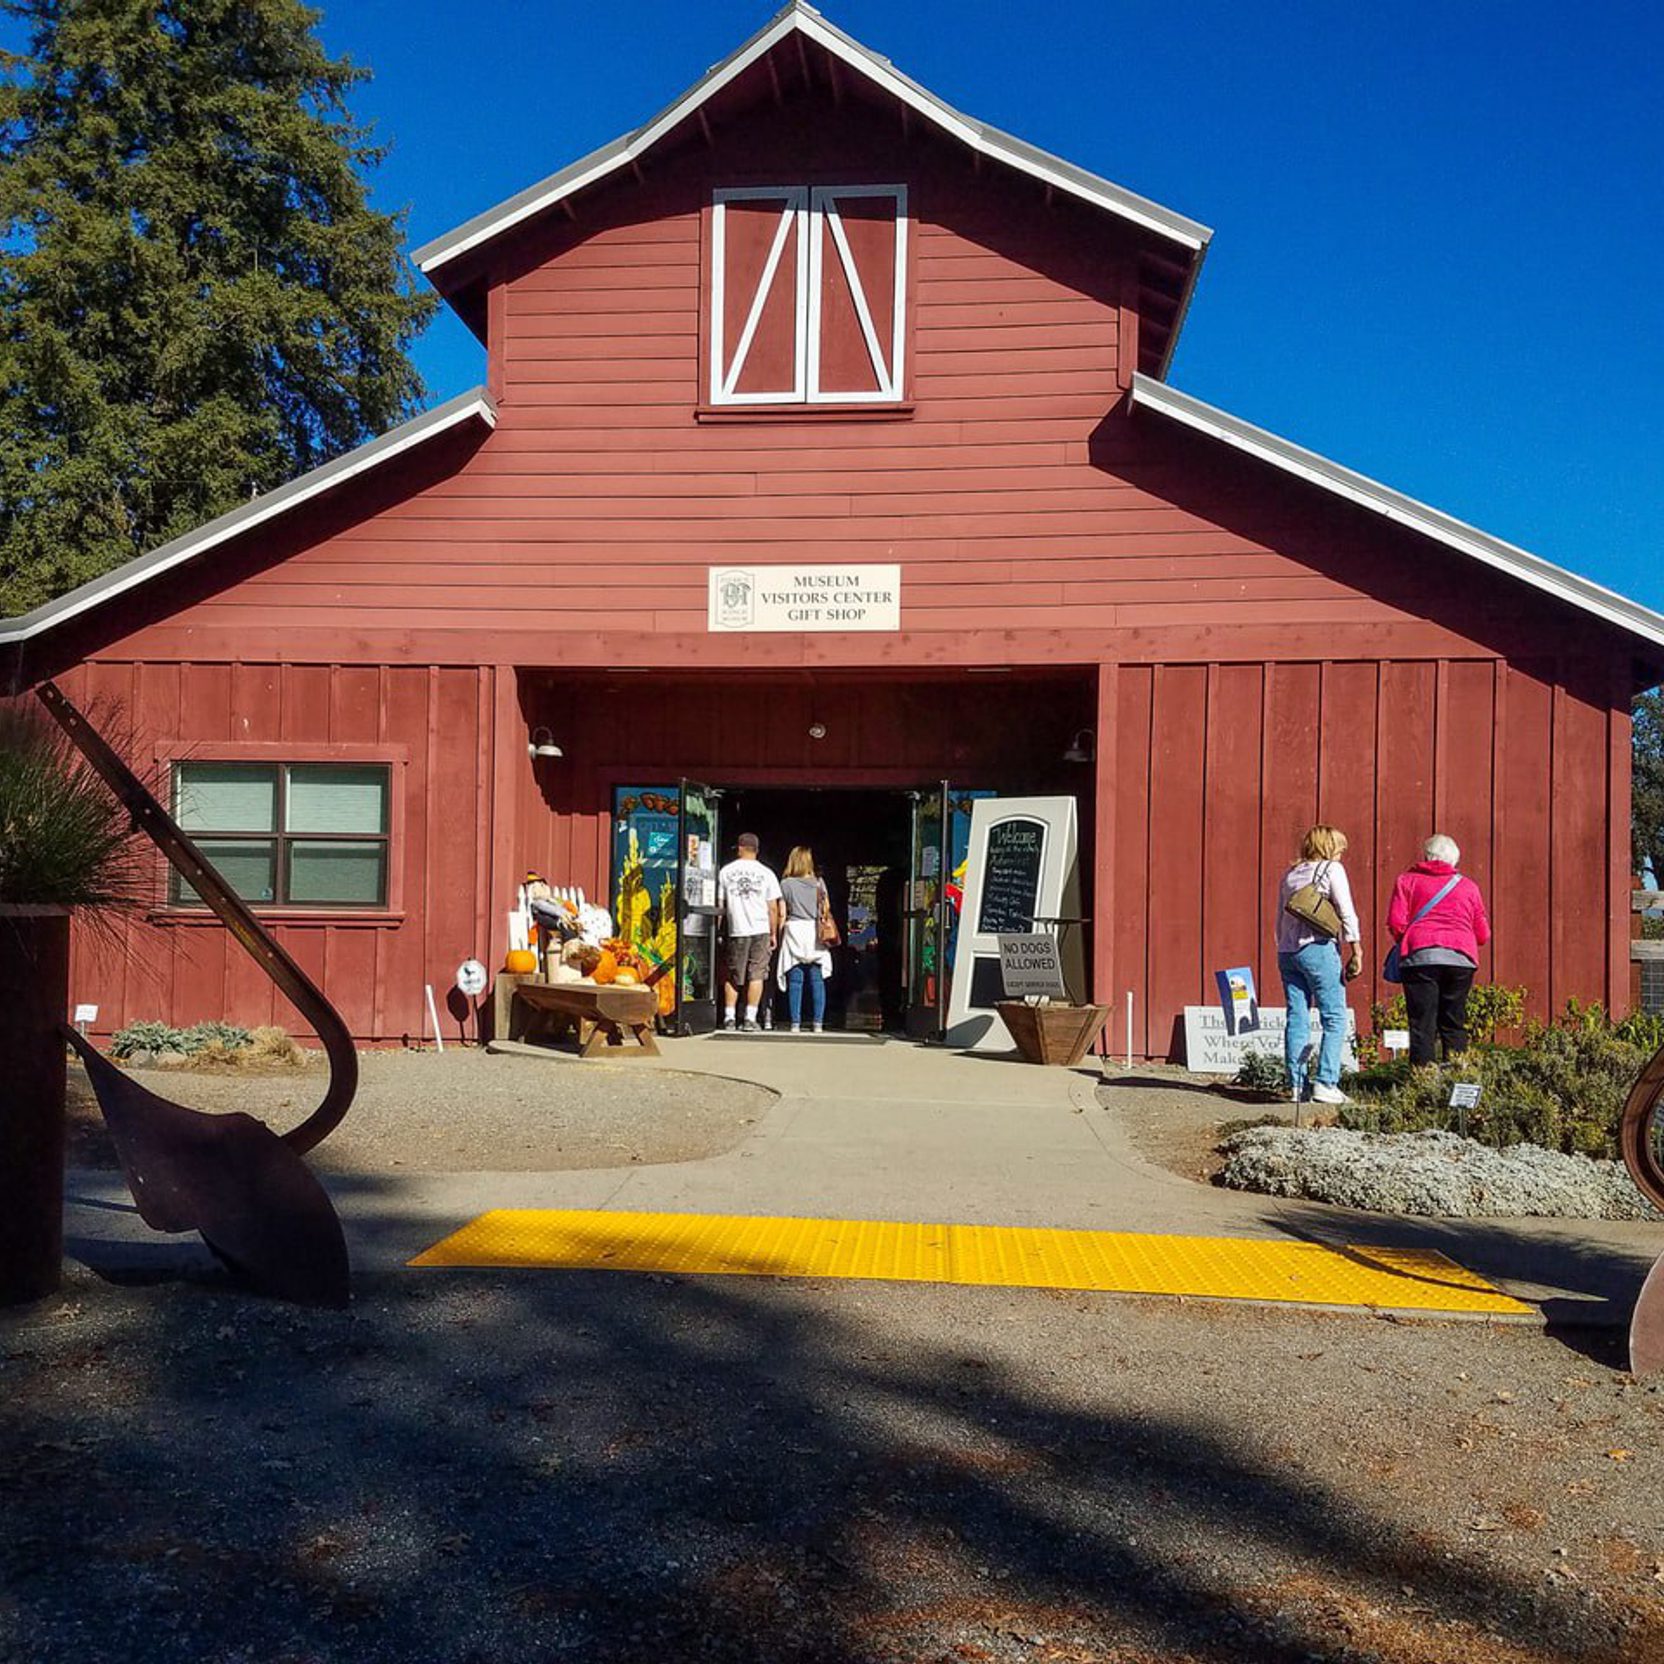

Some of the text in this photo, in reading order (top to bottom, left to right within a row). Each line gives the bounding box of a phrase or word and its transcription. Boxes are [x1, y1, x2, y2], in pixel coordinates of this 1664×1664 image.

[794, 575, 860, 588] MUSEUM
[760, 590, 893, 605] VISITORS CENTER
[788, 608, 867, 621] GIFT SHOP
[1003, 941, 1052, 954] NO DOGS
[1005, 958, 1056, 970] ALLOWED
